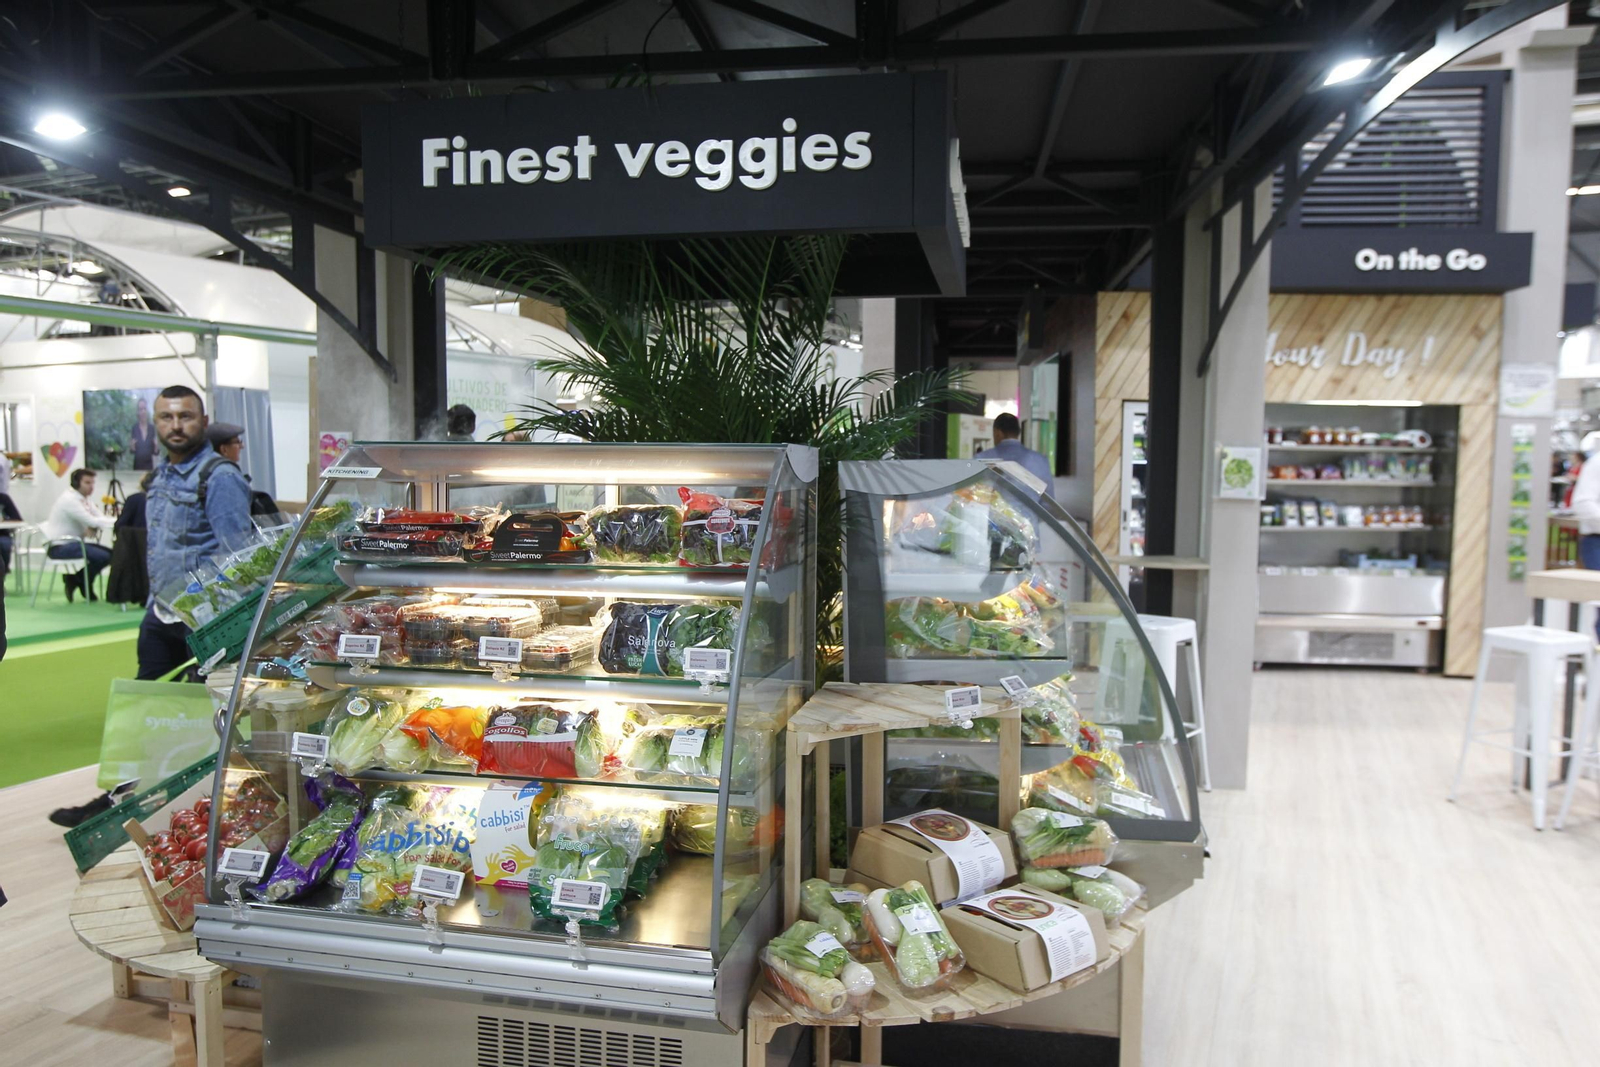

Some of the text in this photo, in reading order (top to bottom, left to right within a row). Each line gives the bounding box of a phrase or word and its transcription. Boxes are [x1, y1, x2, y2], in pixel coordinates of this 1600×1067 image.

[422, 117, 873, 191] Finest veggies
[1355, 247, 1487, 271] On the Go
[1340, 331, 1411, 380] Day
[480, 808, 524, 828] cabbisi
[513, 823, 526, 831] salad
